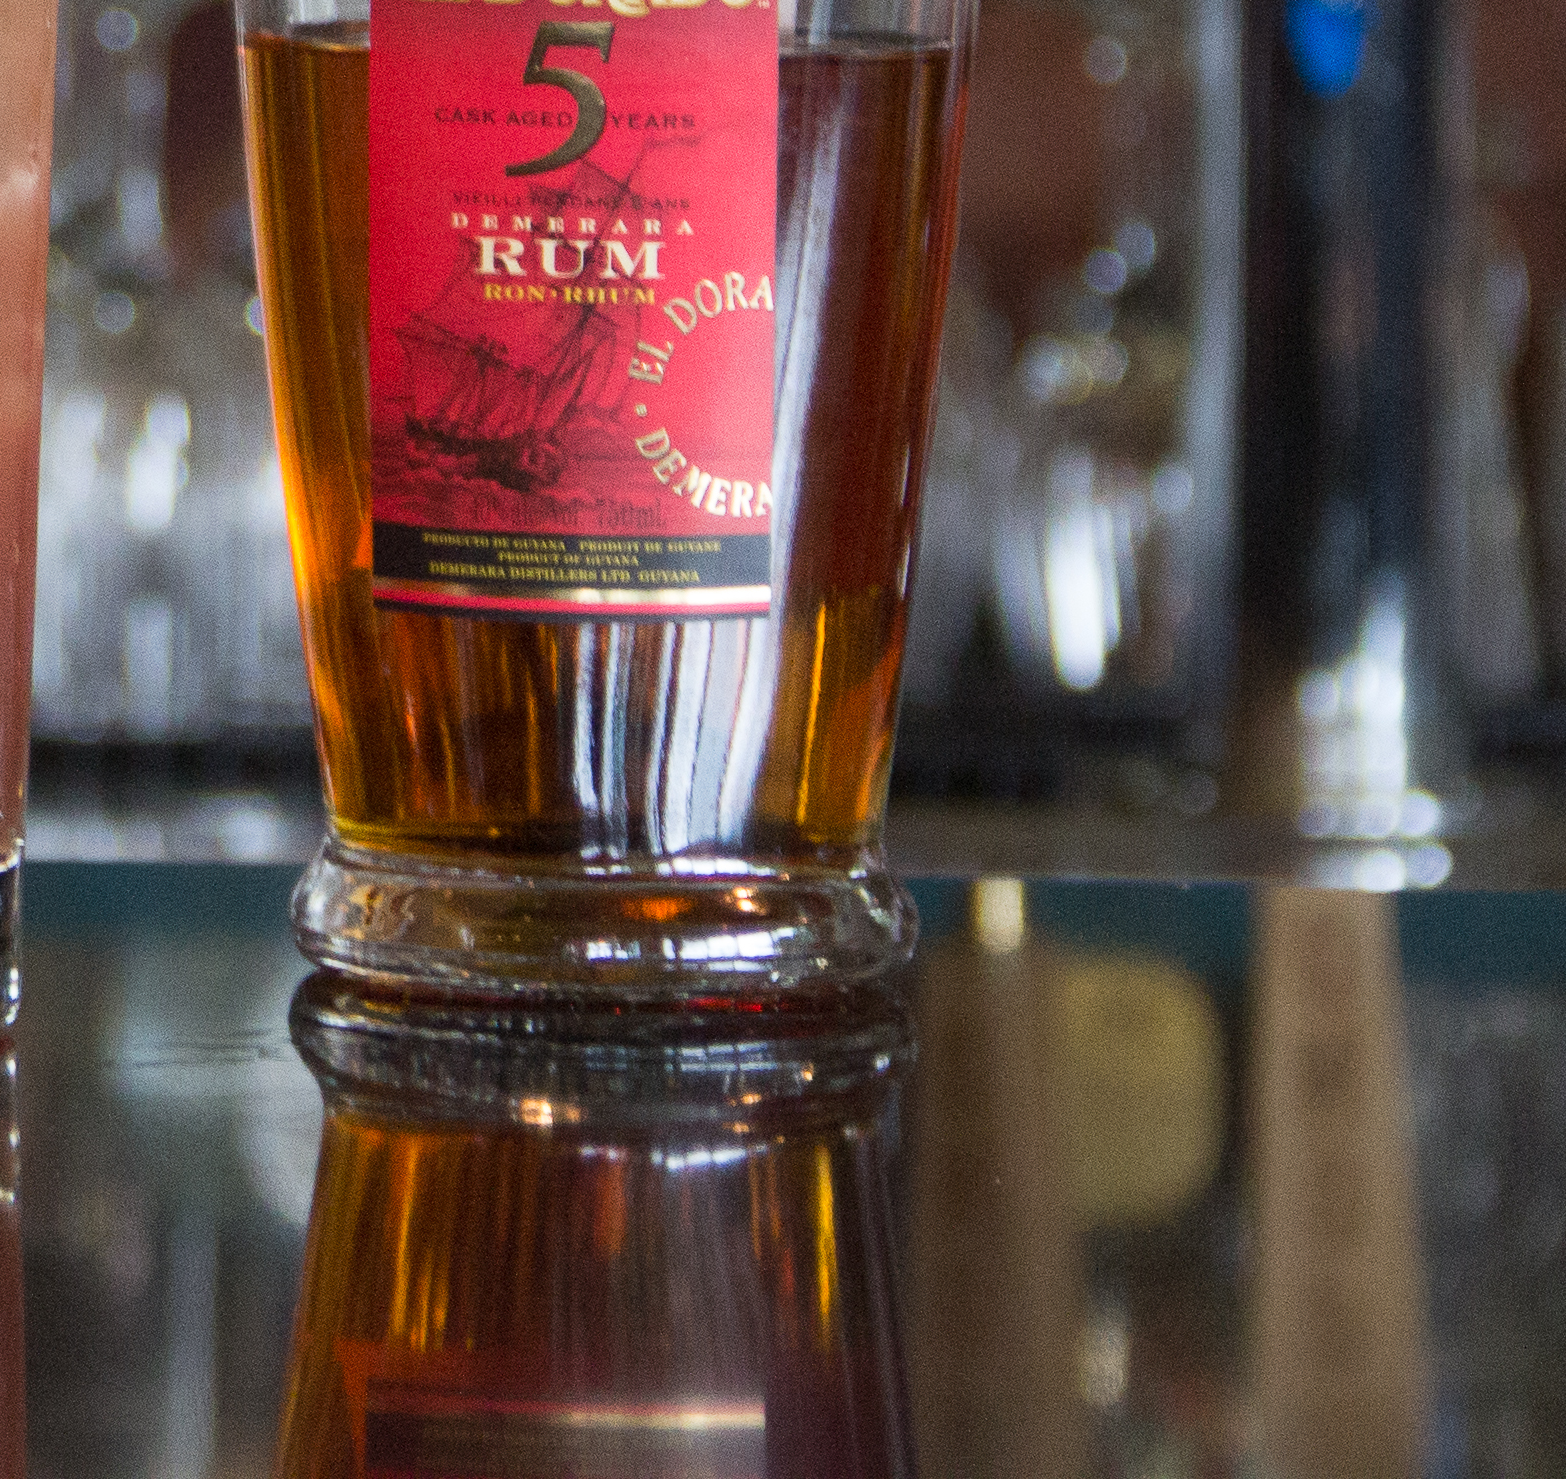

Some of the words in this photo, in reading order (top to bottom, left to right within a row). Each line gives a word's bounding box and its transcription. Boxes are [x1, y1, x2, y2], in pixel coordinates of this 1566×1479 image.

[504, 20, 616, 178] 5
[434, 106, 497, 126] CASK
[505, 109, 574, 130] AGED
[608, 112, 696, 130] YEARS
[450, 211, 695, 236] DEMERARA
[474, 235, 666, 281] RUM
[484, 282, 547, 302] RON
[628, 339, 675, 386] EL
[663, 270, 776, 336] DORA
[427, 560, 506, 579] DEMERARA
[509, 566, 598, 583] DISTILLERS
